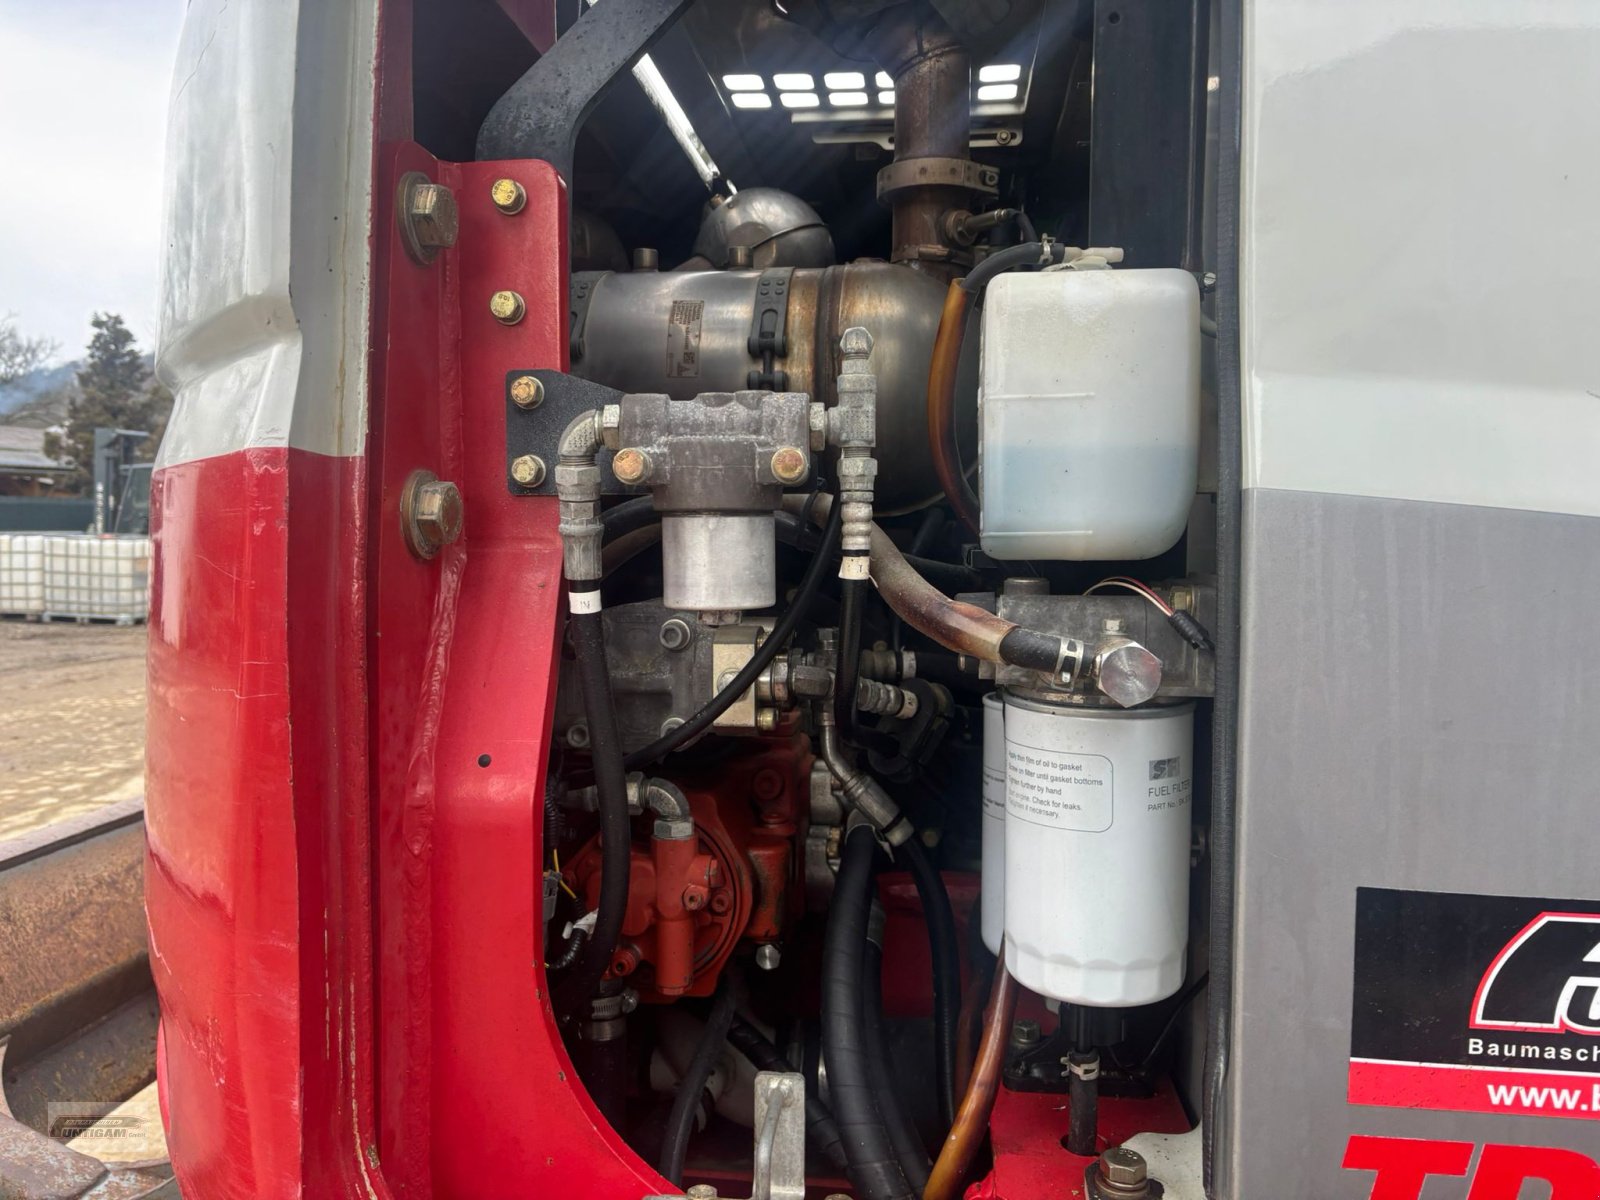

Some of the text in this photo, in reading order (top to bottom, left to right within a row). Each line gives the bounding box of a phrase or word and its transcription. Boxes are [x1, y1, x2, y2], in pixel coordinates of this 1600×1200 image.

[1059, 763, 1082, 771] gasket
[1050, 775, 1072, 784] gasket
[1074, 777, 1103, 786] bottoms
[1037, 785, 1044, 793] by
[1046, 787, 1062, 795] hand
[1148, 786, 1171, 798] FUEL
[1032, 796, 1050, 806] Check
[1147, 802, 1166, 812] PART
